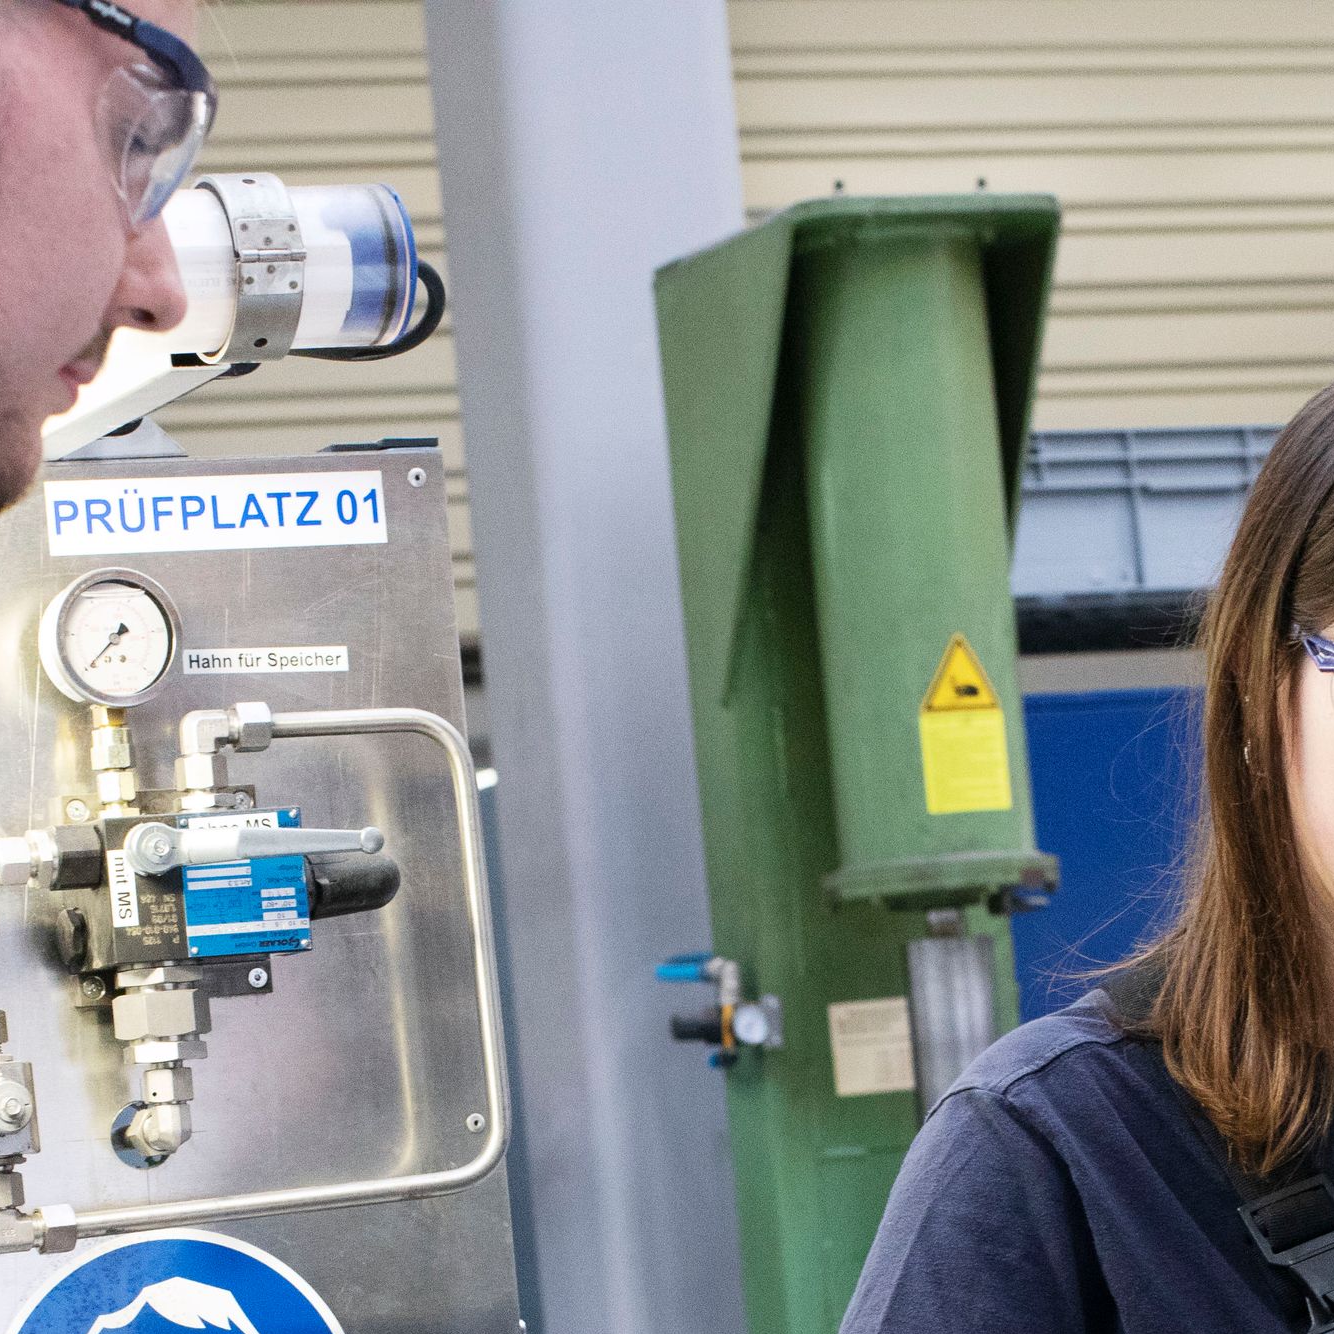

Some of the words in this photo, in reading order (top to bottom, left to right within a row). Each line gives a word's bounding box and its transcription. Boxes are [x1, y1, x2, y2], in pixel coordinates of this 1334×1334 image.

[53, 488, 322, 535] PRÜFPLATZ
[336, 488, 380, 525] 01
[188, 654, 233, 670] Hahn
[238, 652, 262, 668] für
[267, 652, 342, 670] Speicher
[114, 856, 129, 884] mit
[117, 892, 132, 920] MS
